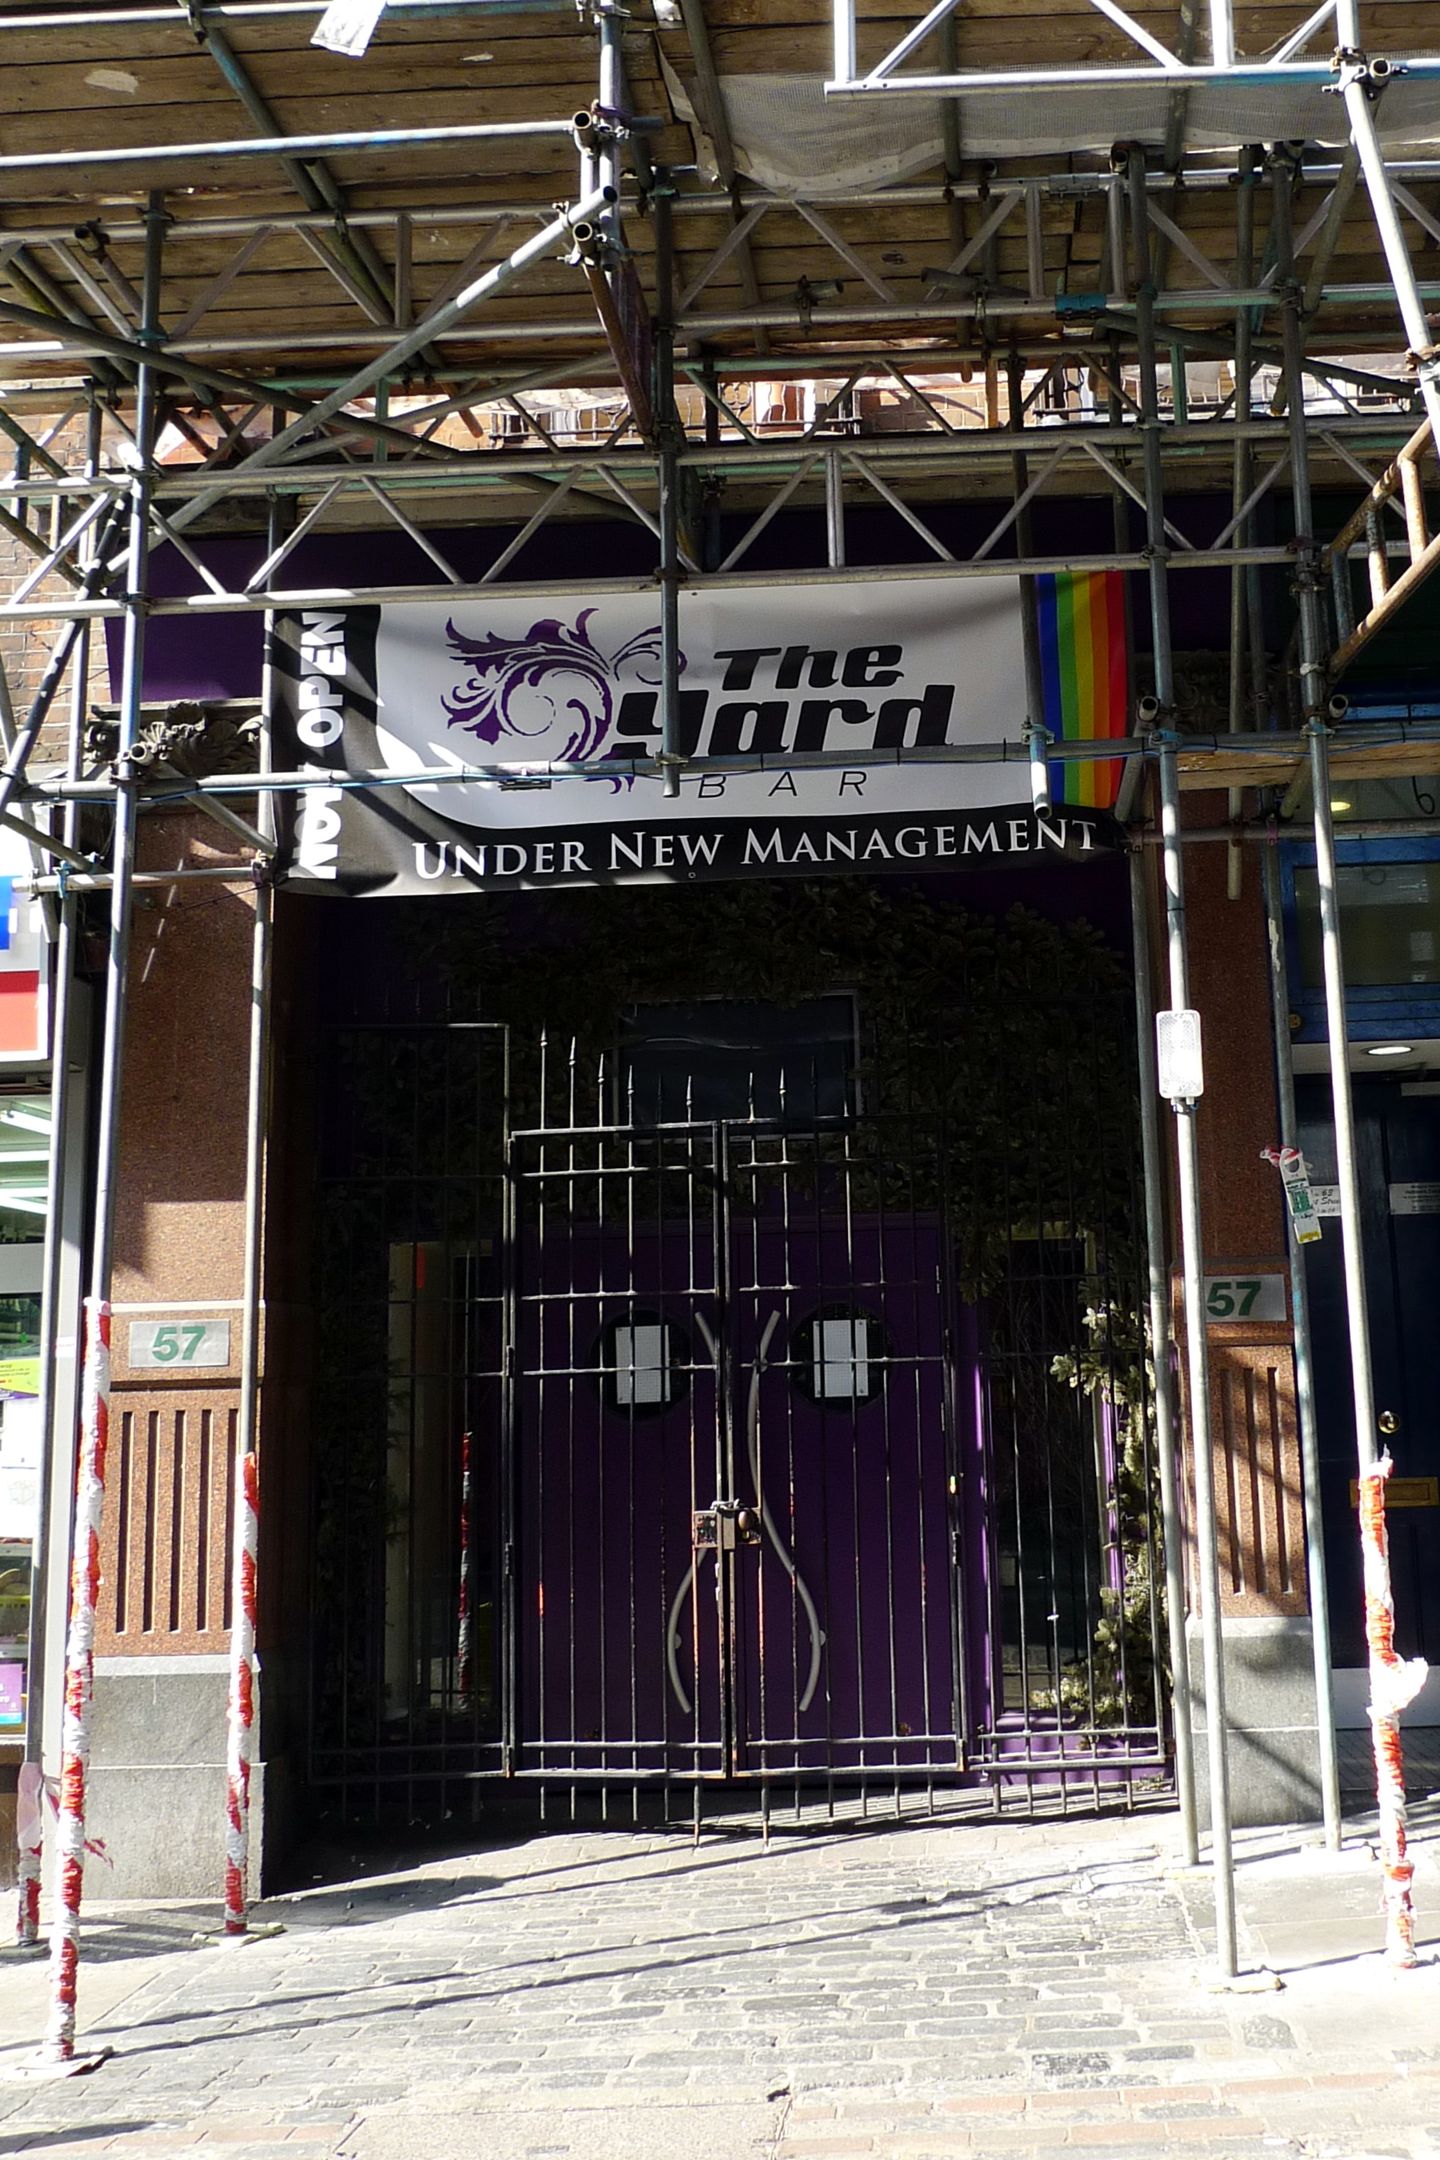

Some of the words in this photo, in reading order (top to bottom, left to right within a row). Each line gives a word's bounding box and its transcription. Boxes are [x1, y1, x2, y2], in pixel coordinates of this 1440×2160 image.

[297, 612, 347, 748] OPEN
[714, 645, 904, 691] The
[698, 770, 868, 799] BAR
[412, 840, 592, 880] UNDER
[608, 831, 724, 872] NEW
[740, 817, 1097, 865] MANAGEMENT
[1206, 1281, 1262, 1317] 57
[151, 1325, 206, 1362] 57
